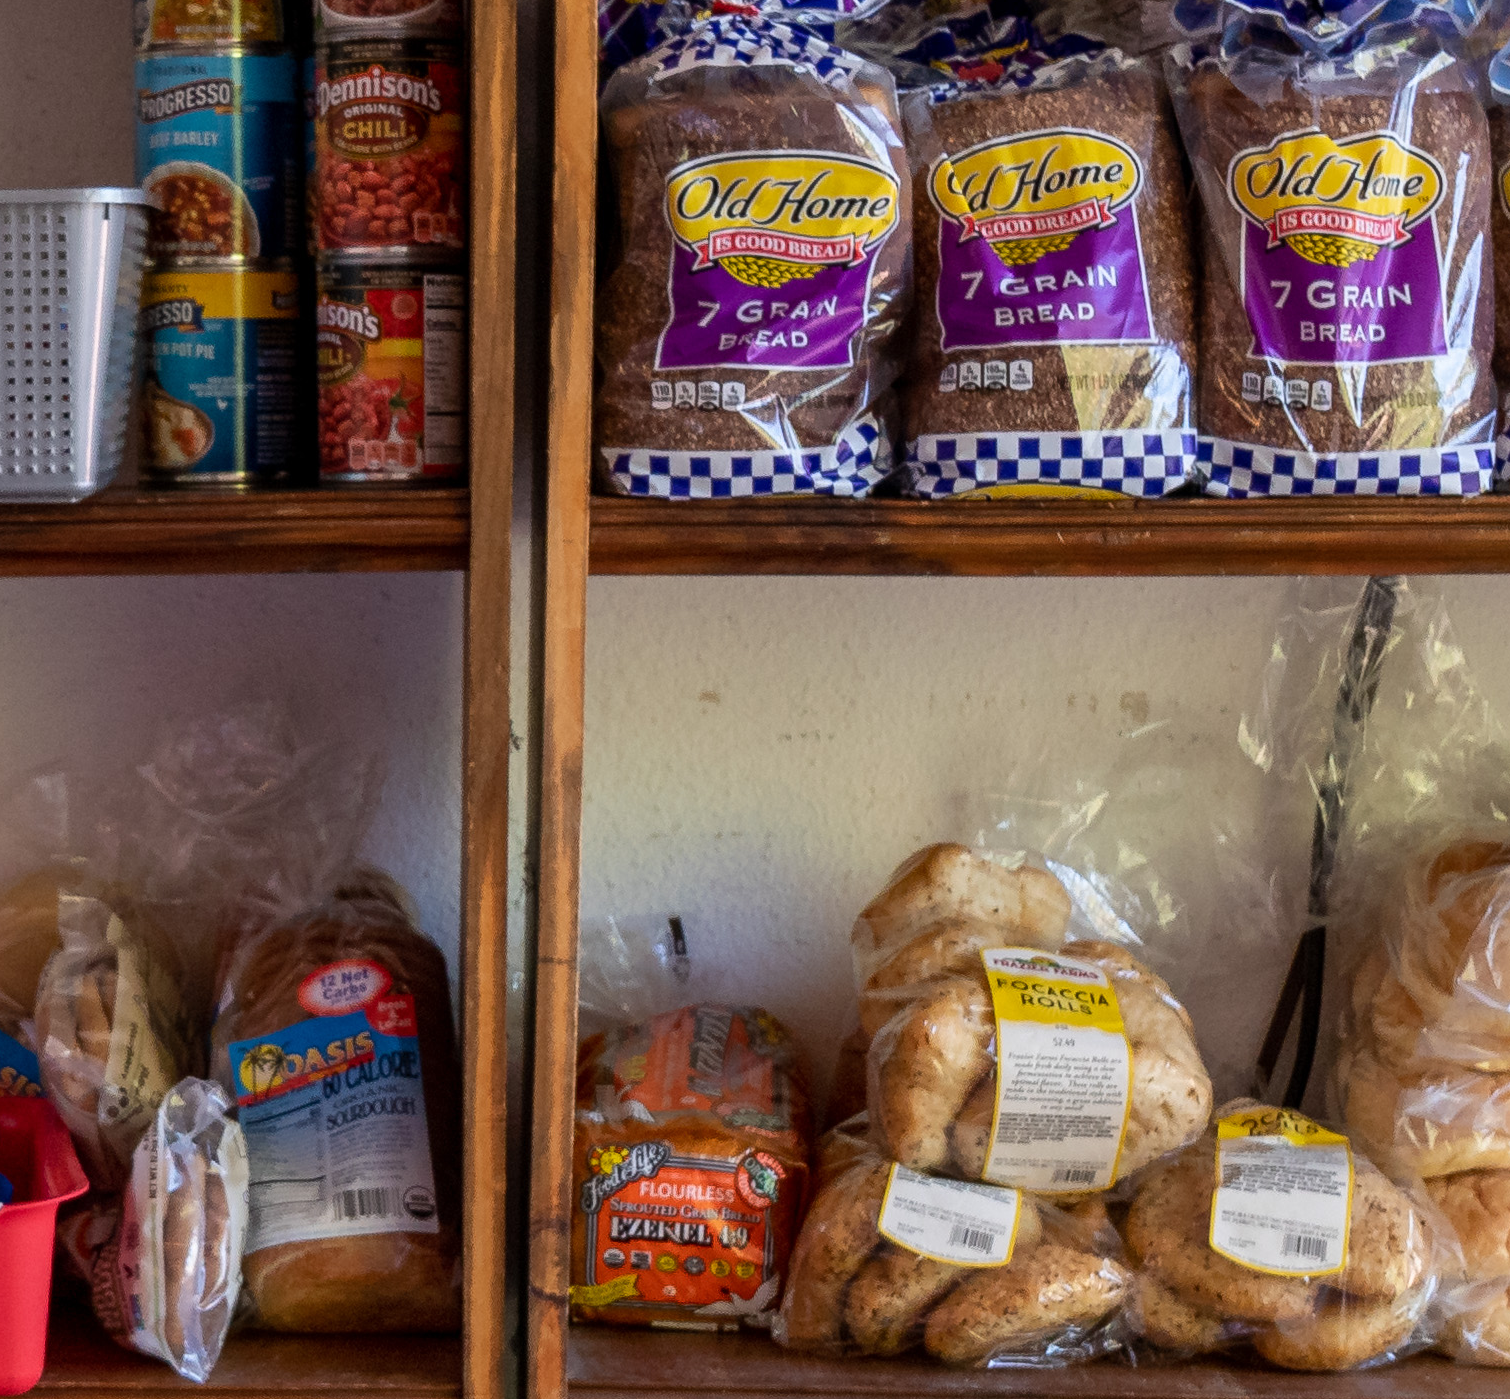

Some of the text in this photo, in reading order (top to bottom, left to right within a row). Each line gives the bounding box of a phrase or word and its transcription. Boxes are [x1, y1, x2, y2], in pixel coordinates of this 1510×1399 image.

[343, 104, 404, 118] ORIGINAL
[179, 131, 219, 147] BARLEY
[342, 122, 407, 139] CHILI
[1007, 147, 1125, 203] Home
[1246, 151, 1425, 205] Old Home
[677, 170, 892, 227] Old Home
[981, 206, 1096, 237] GOOD BREAD
[1281, 211, 1350, 234] IS GOOD
[715, 235, 850, 260] IS GOOD BREAD
[961, 265, 1118, 301] 7 GRAIN
[1271, 279, 1413, 310] 7 GRAIN
[697, 300, 720, 327] 7
[995, 302, 1096, 327] BREAD
[718, 329, 809, 351] BREAD
[1299, 320, 1386, 344] BREAD
[320, 969, 369, 988] 12 Net
[993, 958, 1099, 981] FRAZIER FARMS
[322, 984, 367, 1001] Carbs
[997, 978, 1110, 1007] FOCACCIA
[1021, 993, 1093, 1015] ROLLS
[639, 1182, 735, 1203] FLOURLESS
[610, 1199, 678, 1216] SPROUTED
[610, 1217, 712, 1246] EZEKIEL
